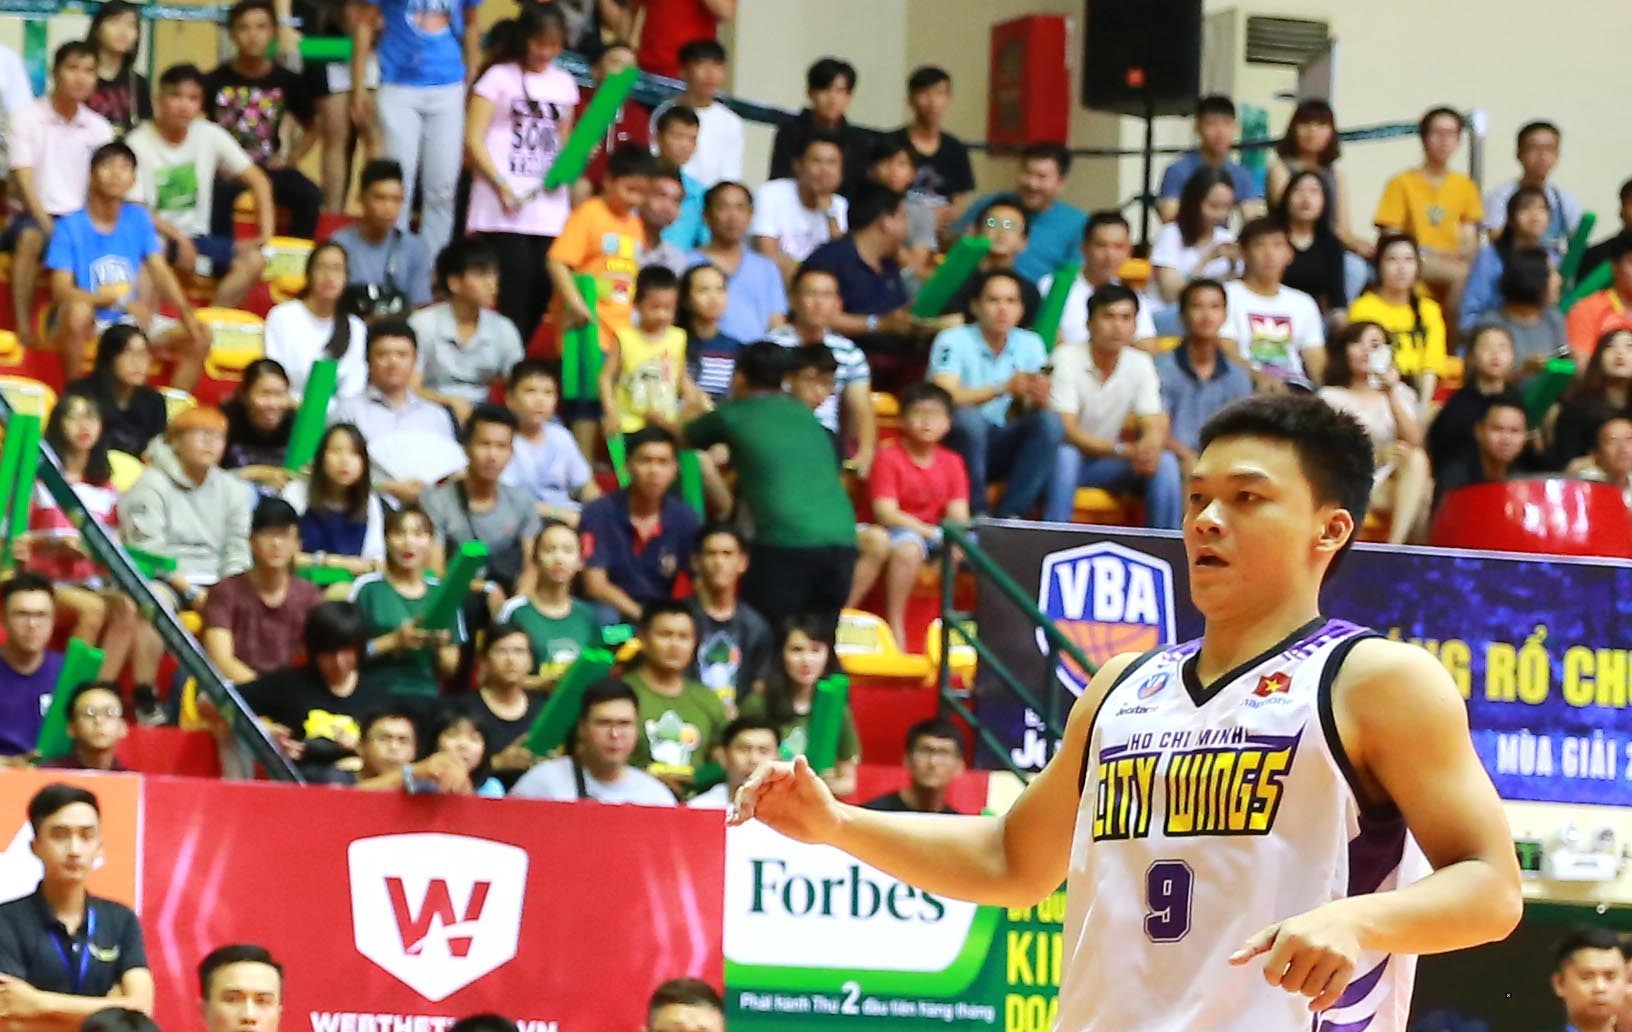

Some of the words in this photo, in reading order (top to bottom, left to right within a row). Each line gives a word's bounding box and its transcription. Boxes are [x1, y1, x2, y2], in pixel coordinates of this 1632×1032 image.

[1054, 556, 1159, 625] VBA
[1485, 624, 1550, 704] RỔ
[1563, 645, 1632, 708] CH
[1130, 731, 1151, 751] HO
[1159, 730, 1192, 749] CHI
[1496, 727, 1554, 777] MÙA
[1091, 752, 1161, 842] CITY
[1164, 745, 1296, 838] WINGS
[748, 857, 946, 923] Forbes
[1143, 859, 1195, 943] 9
[841, 980, 861, 1015] 2
